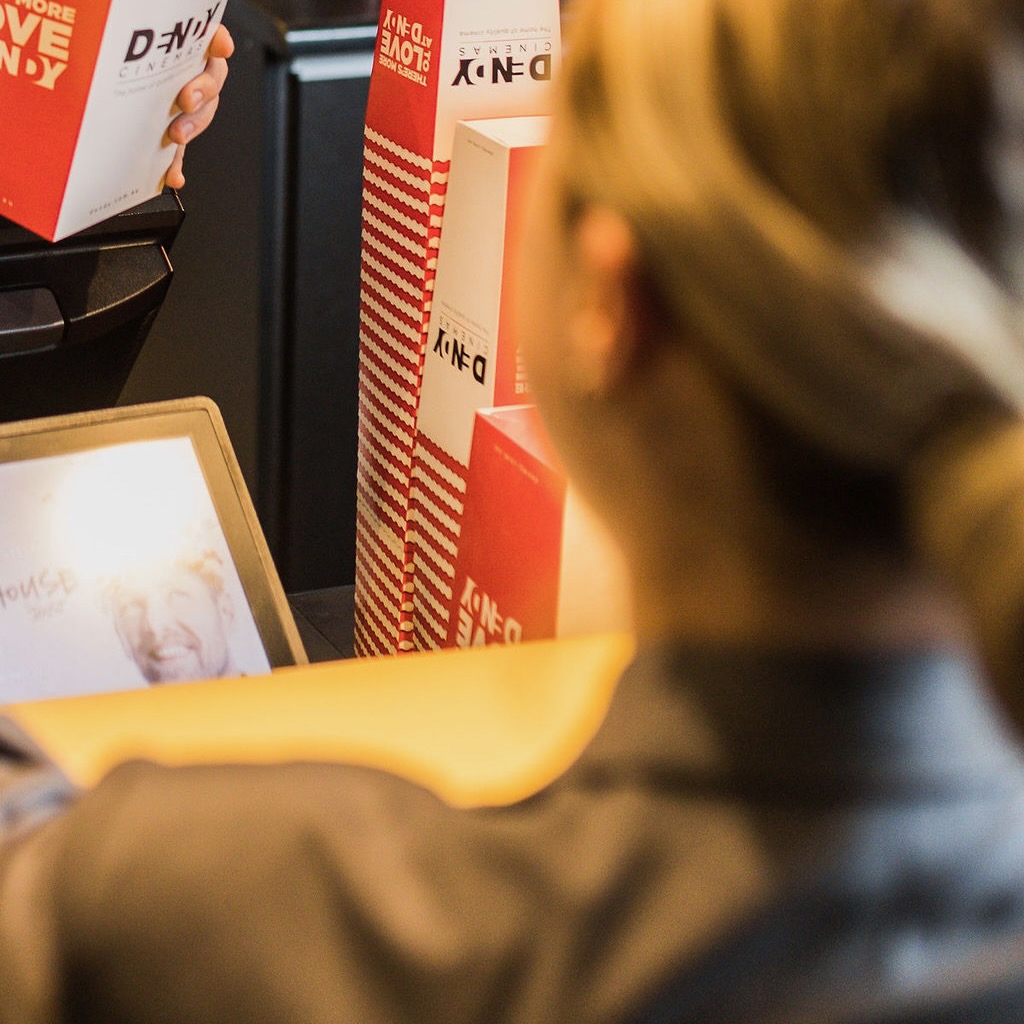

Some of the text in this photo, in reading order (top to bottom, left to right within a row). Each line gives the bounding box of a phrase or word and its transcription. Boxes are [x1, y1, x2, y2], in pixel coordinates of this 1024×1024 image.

[382, 9, 433, 48] AT DENDY
[378, 54, 397, 72] MORE
[380, 29, 424, 72] LOVE
[459, 42, 552, 57] CINEMAS
[451, 54, 551, 86] DENDY
[433, 327, 487, 385] DENDY
